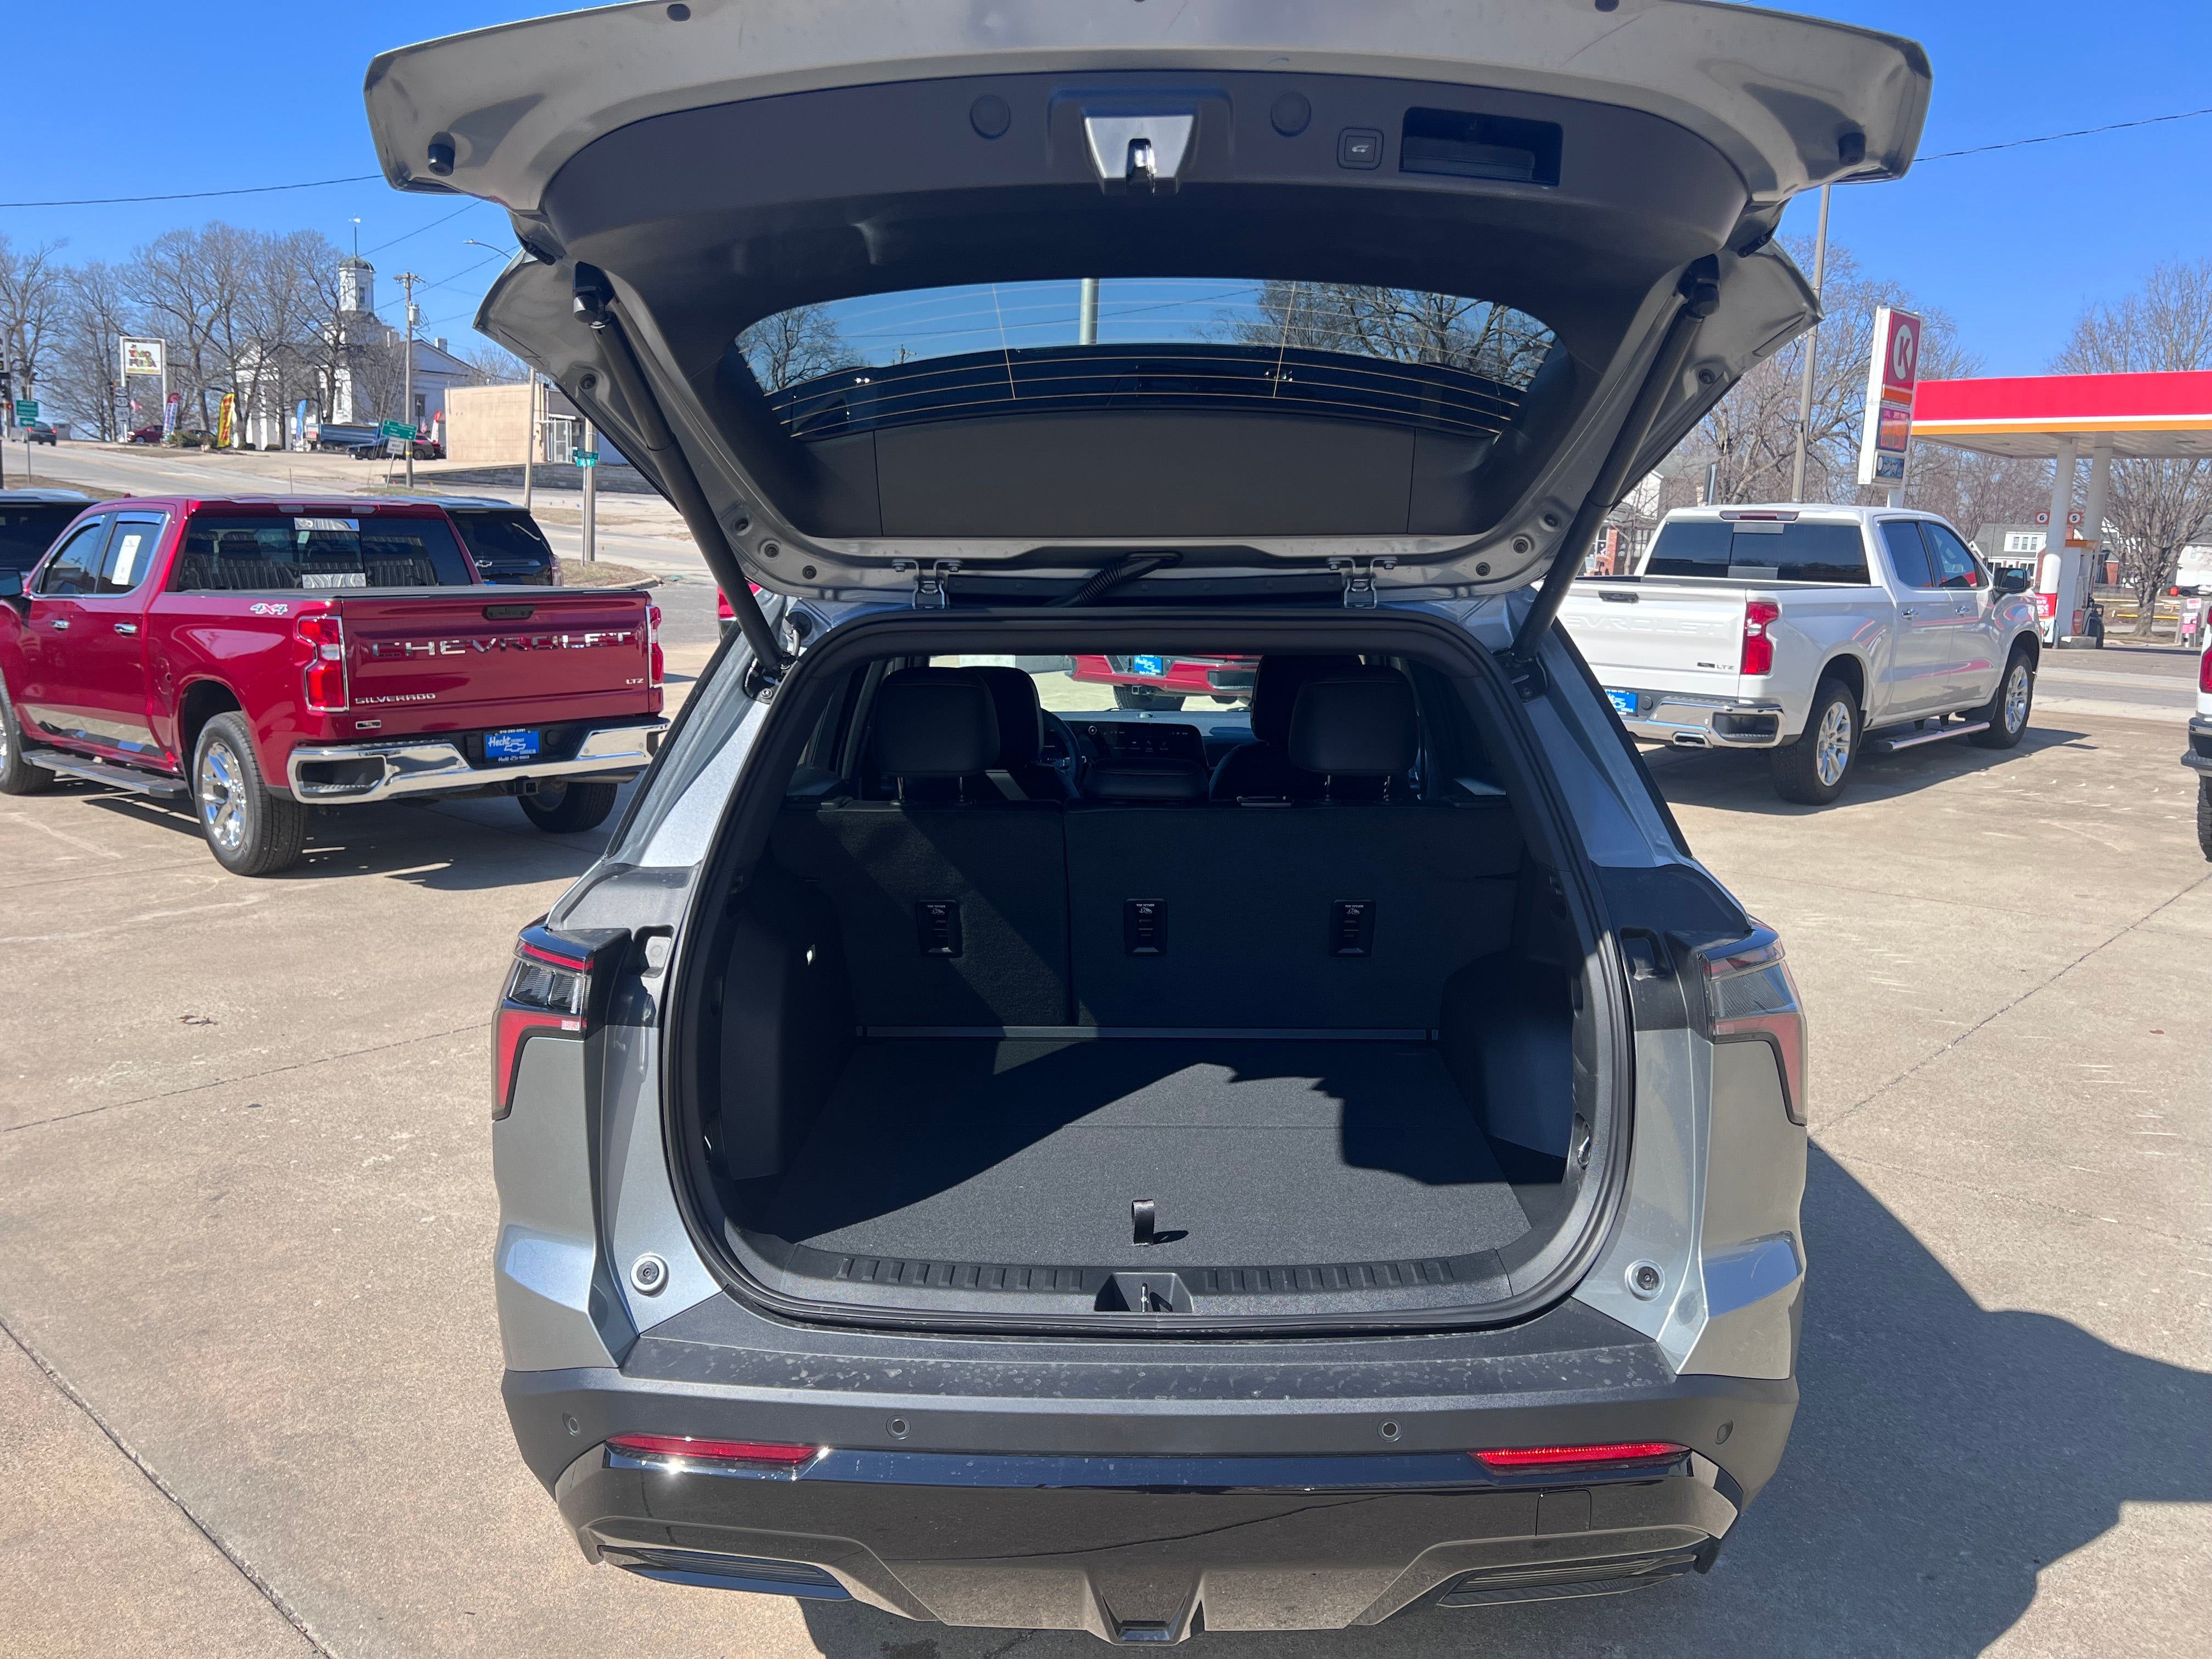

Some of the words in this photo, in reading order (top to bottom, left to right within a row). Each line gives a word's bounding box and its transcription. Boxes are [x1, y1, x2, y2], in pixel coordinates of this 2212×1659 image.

[1898, 336, 1911, 370] K
[1564, 613, 1725, 635] EVROLET
[373, 631, 631, 657] CHEVROLET
[355, 693, 436, 704] SILVERADO
[488, 735, 511, 747] Hecht
